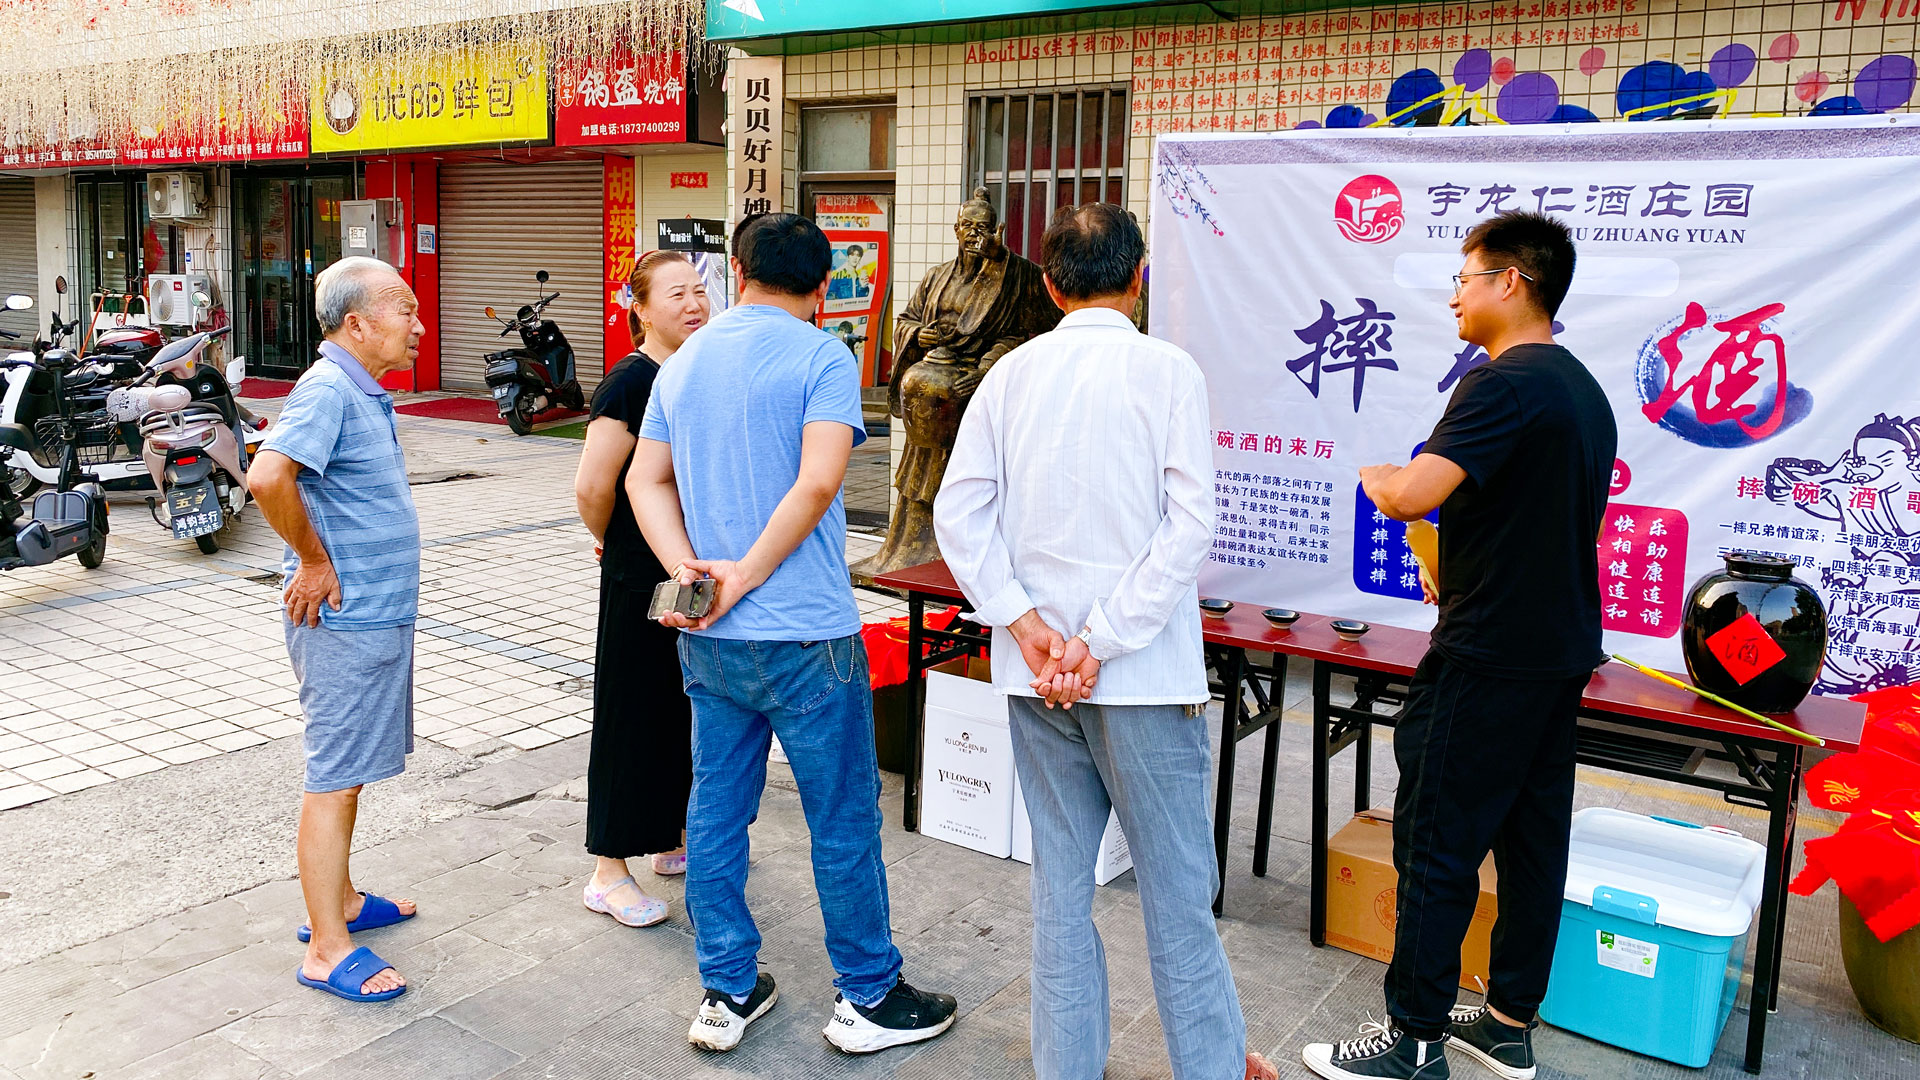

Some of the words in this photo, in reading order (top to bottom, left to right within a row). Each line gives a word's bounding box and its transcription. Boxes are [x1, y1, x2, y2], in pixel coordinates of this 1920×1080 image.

[967, 40, 1015, 64] About
[1019, 38, 1040, 60] Us
[1428, 180, 1755, 219] 宇龙仁酒庄园
[608, 165, 635, 282] 胡辣汤
[1427, 225, 1449, 239] YU
[1593, 227, 1679, 243] ZHUANG
[1687, 228, 1747, 244] YUAN
[1725, 635, 1759, 666] 酒
[952, 739, 968, 749] LONG
[938, 769, 991, 795] YULONGREN
